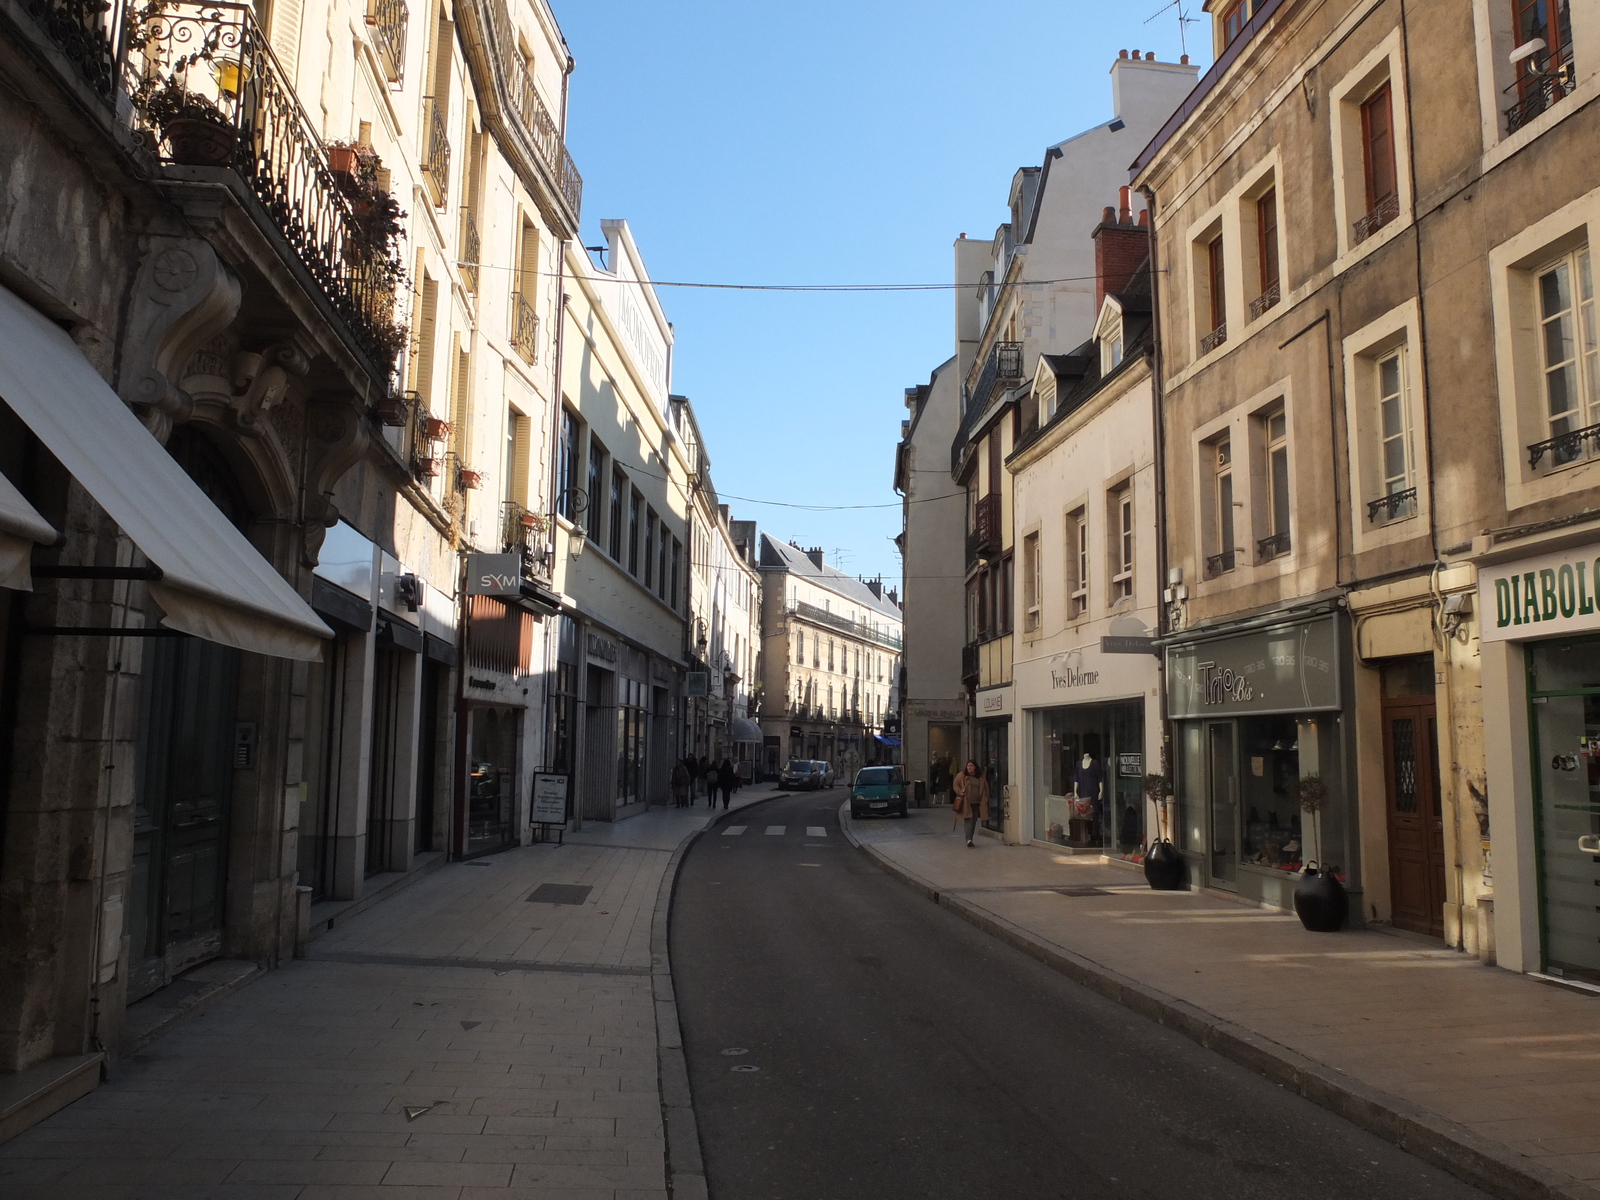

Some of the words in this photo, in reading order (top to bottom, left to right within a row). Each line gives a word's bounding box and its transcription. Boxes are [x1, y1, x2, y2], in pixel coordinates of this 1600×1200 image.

[620, 295, 664, 396] MONOPRIX
[480, 573, 517, 591] SYM
[1125, 639, 1153, 648] Delorm
[1050, 669, 1067, 690] Yves
[1066, 665, 1100, 688] Delorme
[1197, 660, 1235, 705] Trio
[1231, 674, 1254, 702] Bis
